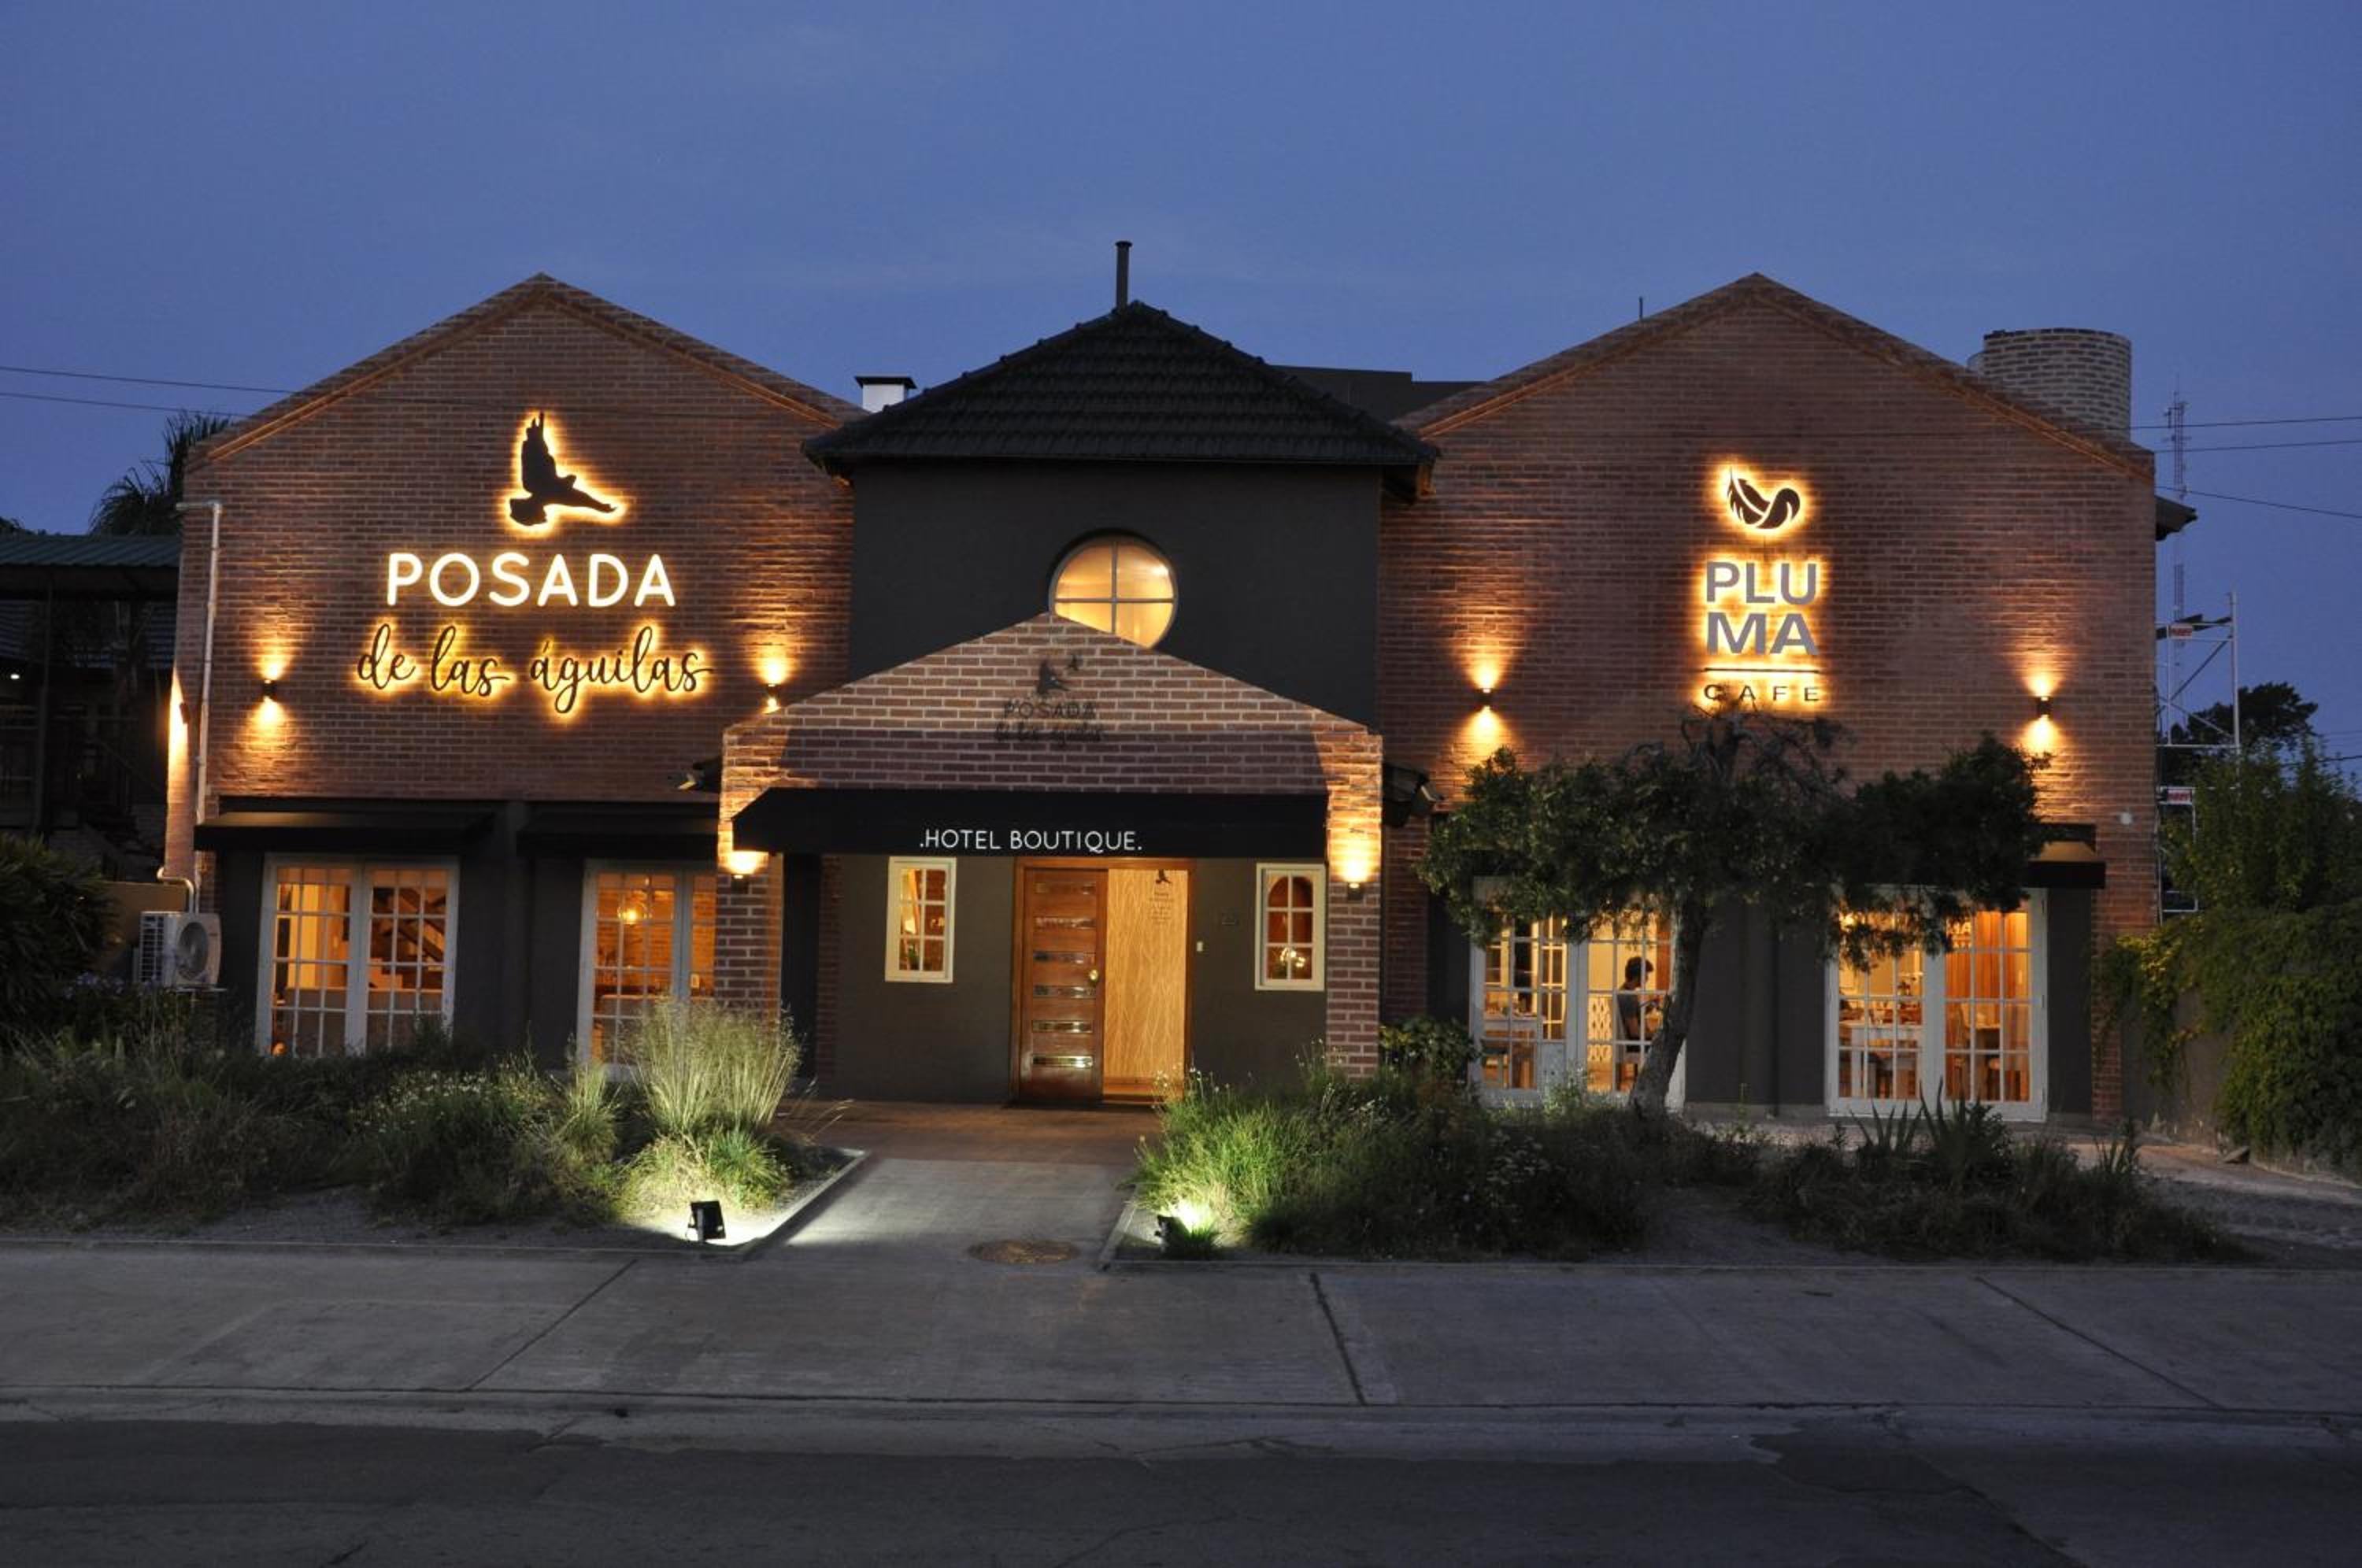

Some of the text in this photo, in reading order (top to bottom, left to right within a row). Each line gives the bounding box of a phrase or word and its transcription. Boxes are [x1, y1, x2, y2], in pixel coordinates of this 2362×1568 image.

[387, 553, 676, 607] POSADA
[1706, 561, 1817, 605] PLU
[1706, 612, 1820, 656] MA
[357, 623, 714, 713] de las águilas
[1704, 683, 1820, 701] CAFE
